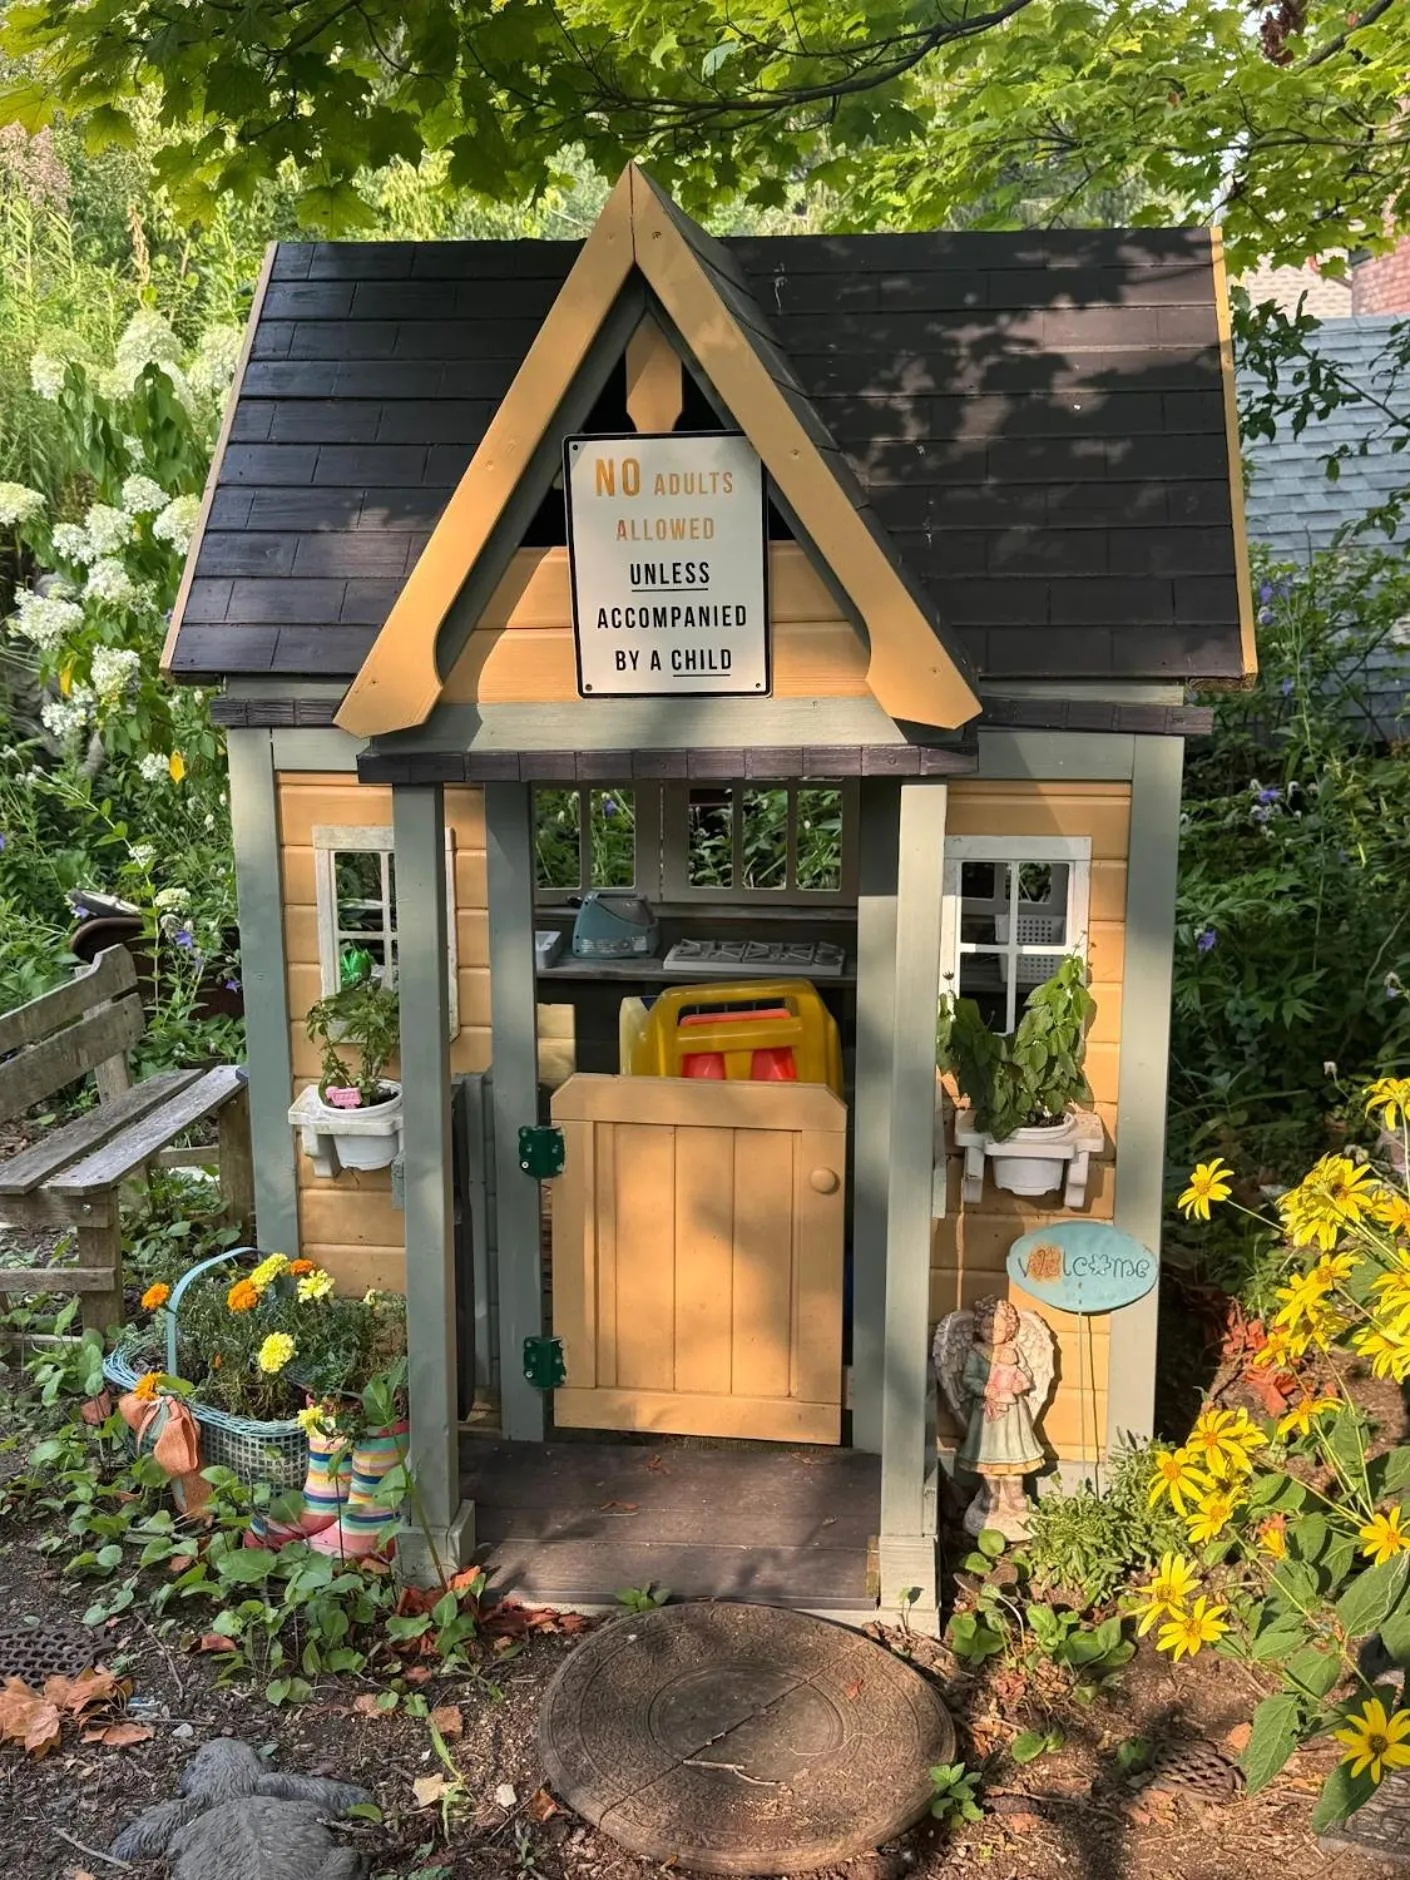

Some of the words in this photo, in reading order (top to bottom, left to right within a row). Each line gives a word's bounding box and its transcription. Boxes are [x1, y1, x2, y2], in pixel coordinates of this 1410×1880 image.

[595, 458, 640, 496] NO
[654, 471, 733, 496] ADULTS
[617, 517, 714, 541] ALLOWED
[630, 562, 710, 585] UNLESS
[597, 605, 747, 629] ACCOMPANIED
[616, 650, 640, 671] BY
[650, 650, 662, 671] A
[671, 649, 732, 671] CHILD
